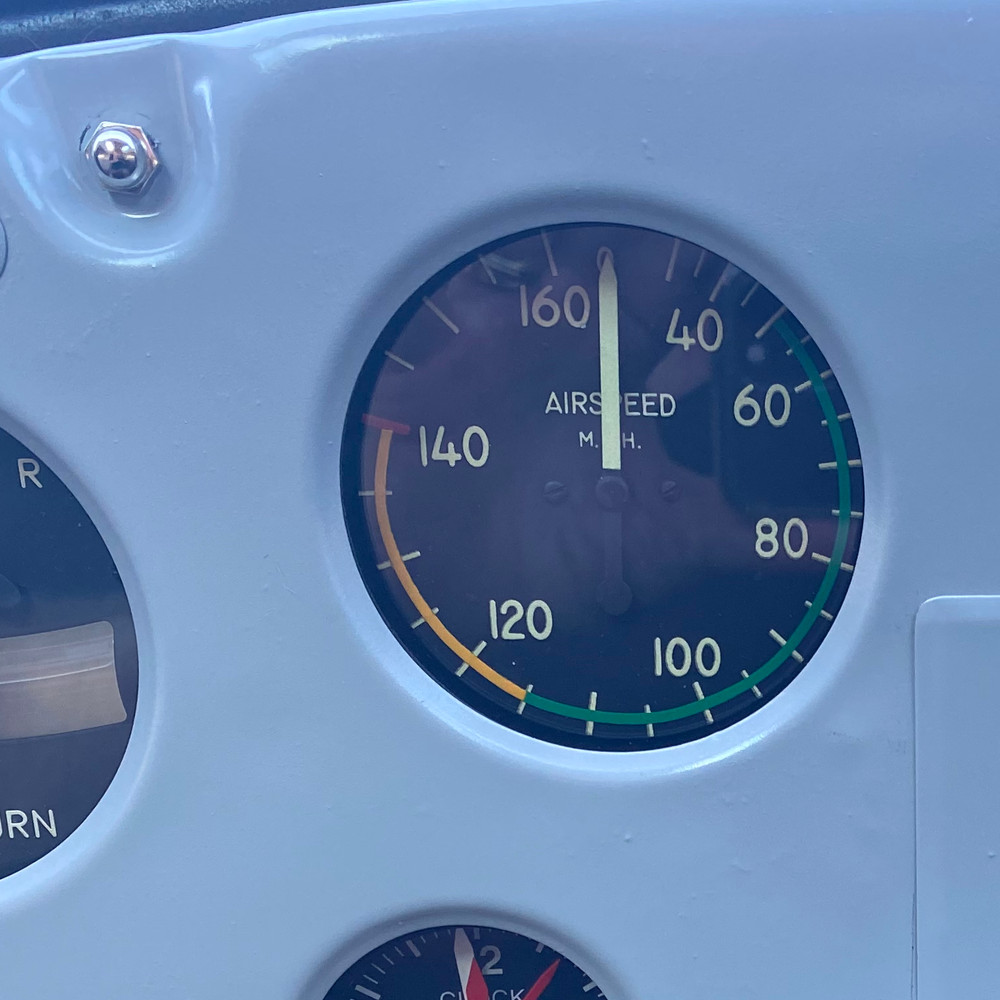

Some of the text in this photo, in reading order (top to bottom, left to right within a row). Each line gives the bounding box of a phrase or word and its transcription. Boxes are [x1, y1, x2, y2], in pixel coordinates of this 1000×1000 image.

[520, 285, 591, 328] 160
[666, 308, 723, 352] 40
[545, 391, 677, 418] AIRSEED
[733, 384, 791, 427] 60
[419, 425, 490, 468] 140
[18, 458, 42, 489] R
[755, 517, 809, 559] 80
[489, 599, 553, 640] 120
[654, 637, 721, 677] 100
